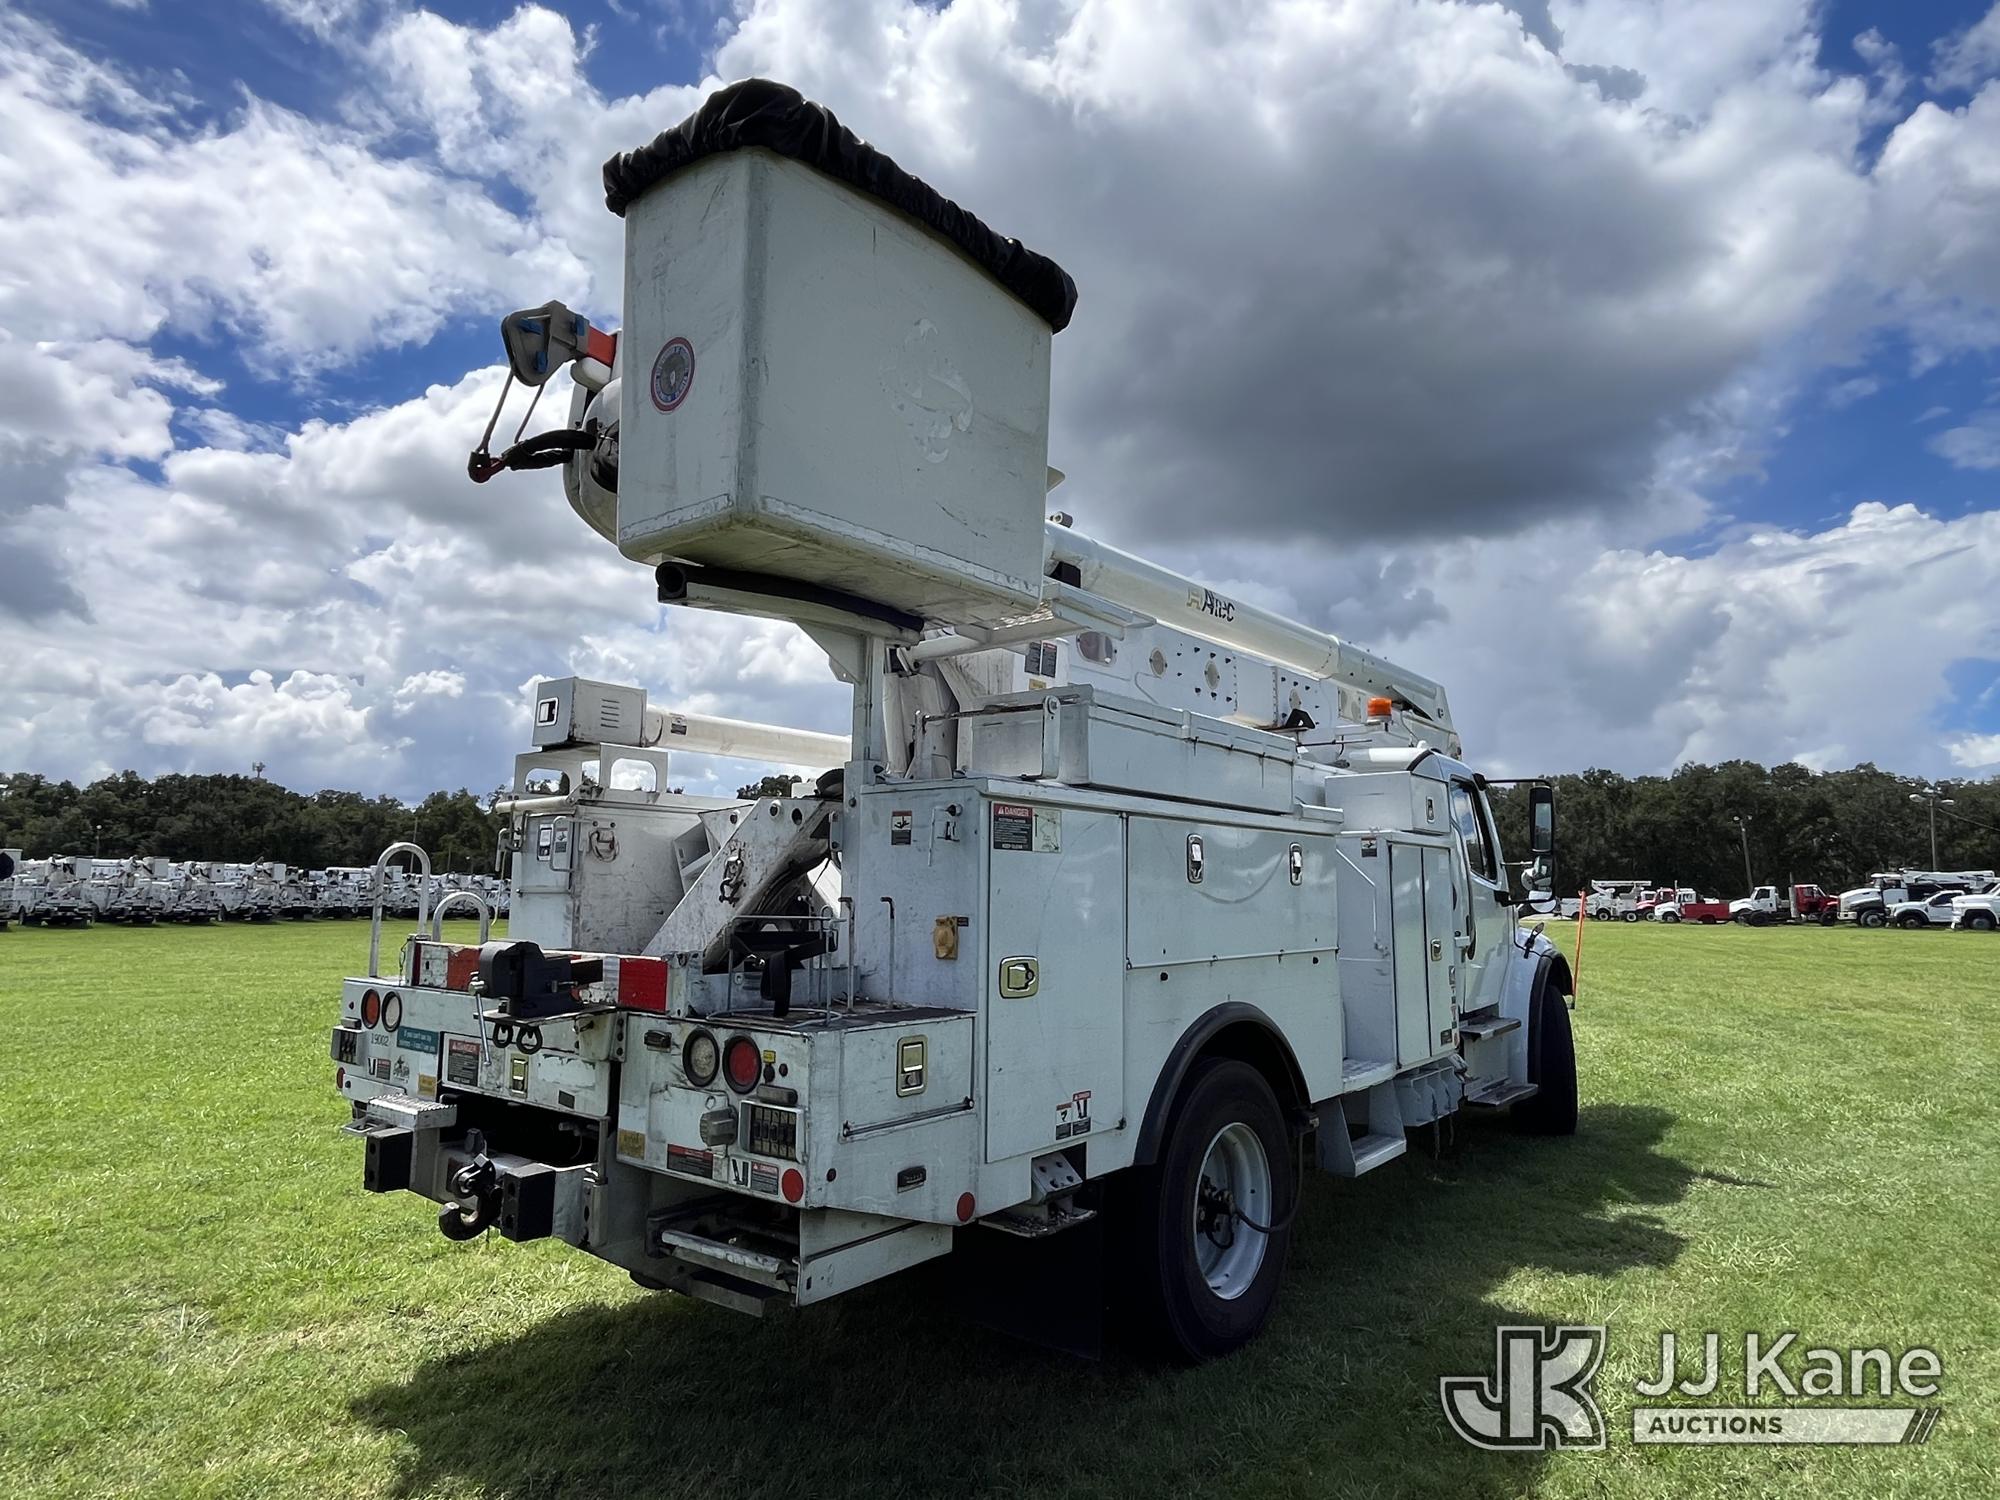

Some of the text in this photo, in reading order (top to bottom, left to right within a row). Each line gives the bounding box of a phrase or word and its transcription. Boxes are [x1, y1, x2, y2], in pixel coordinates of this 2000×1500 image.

[1202, 588, 1235, 622] Altec
[1004, 806, 1029, 817] DANGER
[371, 1033, 389, 1047] 19002
